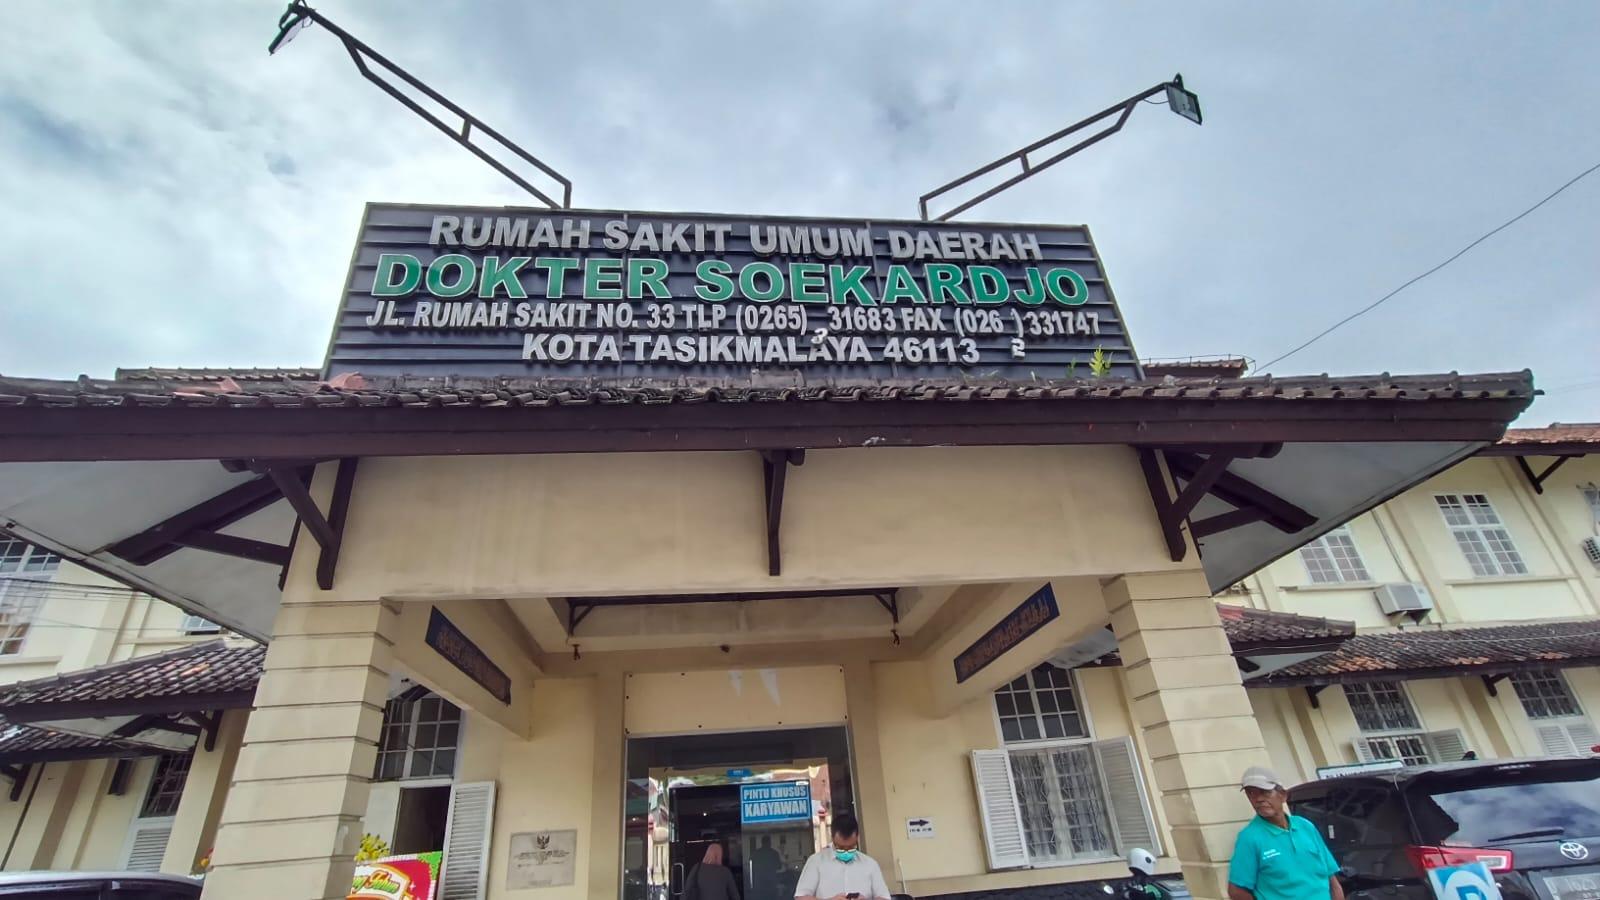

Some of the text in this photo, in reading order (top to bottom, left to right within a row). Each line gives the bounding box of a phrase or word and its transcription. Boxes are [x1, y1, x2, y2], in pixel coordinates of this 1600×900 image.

[428, 215, 1044, 261] RUMAH SAKIT UMUM DAERAH
[371, 253, 1090, 306] DOKTER SOEKARDJO
[366, 300, 405, 328] JL.
[413, 302, 510, 328] RUMAH
[514, 303, 592, 328] SAKIT
[596, 303, 639, 329] NO.
[647, 303, 676, 329] 33
[681, 304, 727, 330] TLP
[735, 304, 808, 336] (0265)
[827, 306, 897, 332] 31683
[901, 307, 947, 333] FAX
[521, 333, 981, 364] KOTA TASIKMALAYA 46113
[743, 786, 806, 800] PINTU KHUSUS
[744, 800, 808, 817] KARYAWAN
